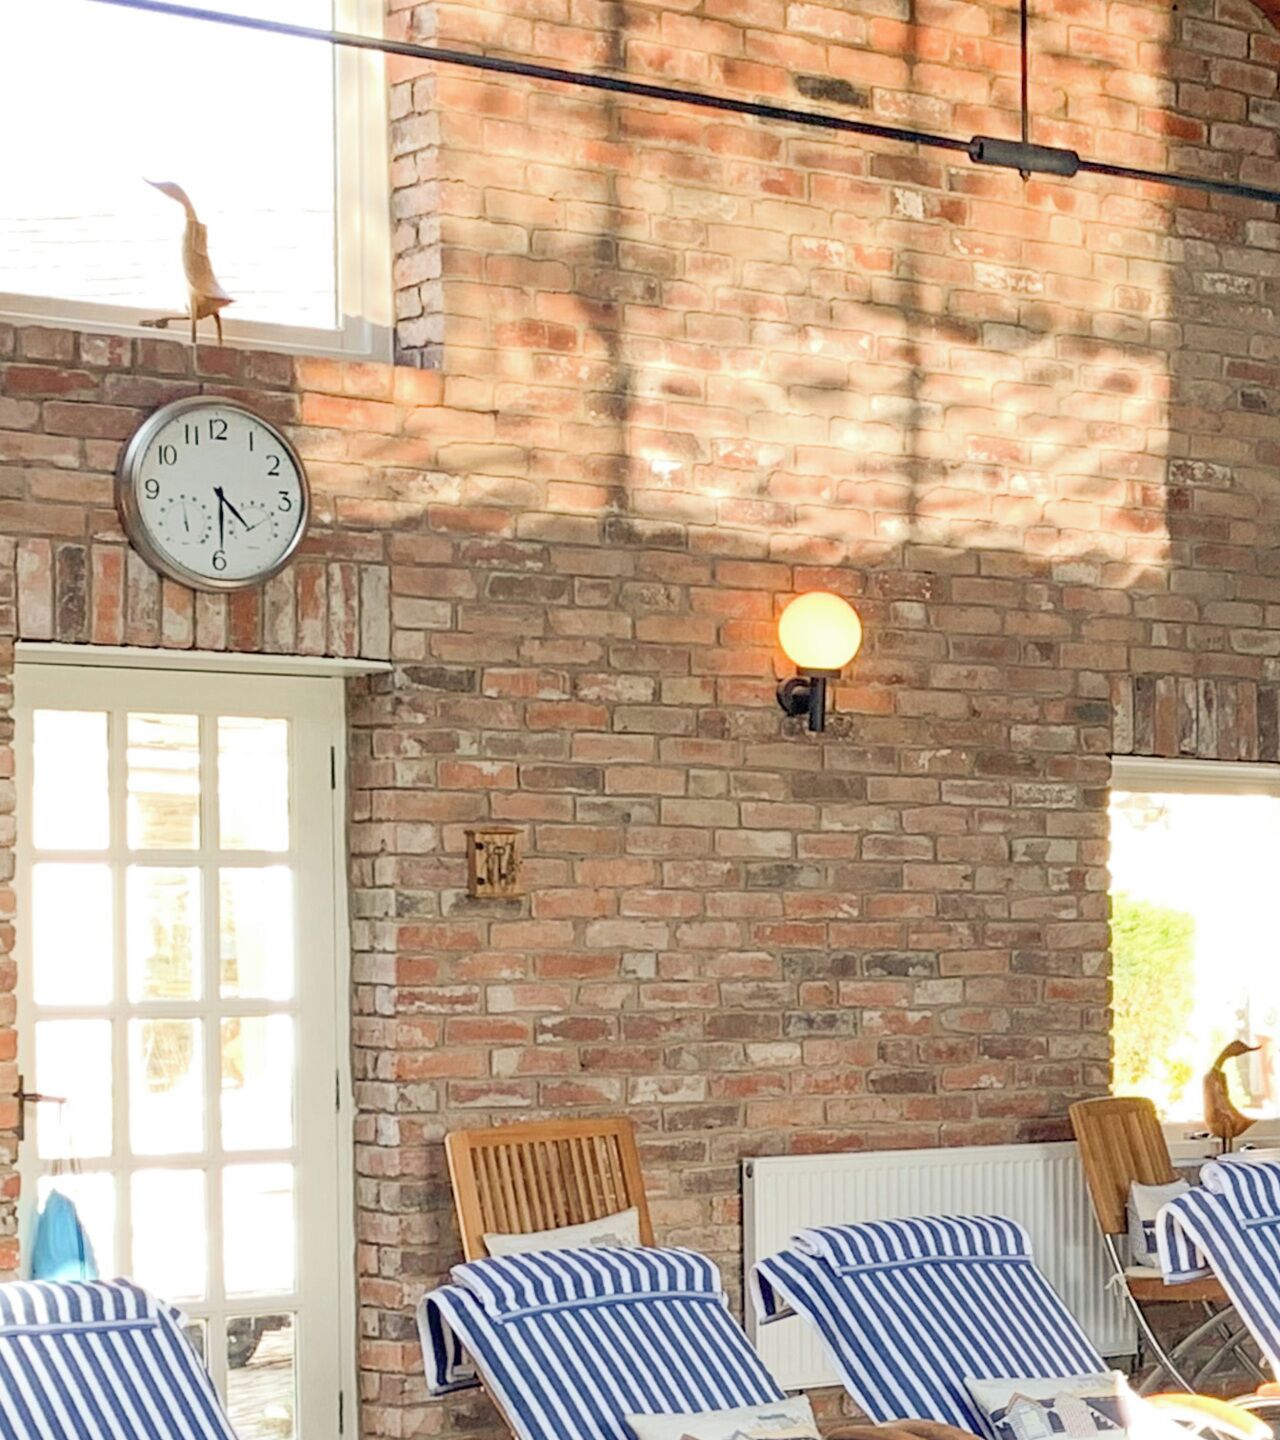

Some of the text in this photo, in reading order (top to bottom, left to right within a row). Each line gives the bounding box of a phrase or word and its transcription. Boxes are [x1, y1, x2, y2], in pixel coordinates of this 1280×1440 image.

[185, 424, 199, 445] 11
[209, 419, 228, 440] 12
[249, 431, 254, 451] 1
[158, 445, 178, 465] 10
[266, 455, 280, 476] 2
[144, 478, 160, 499] 9
[278, 491, 292, 512] 3
[212, 550, 227, 571] 6
